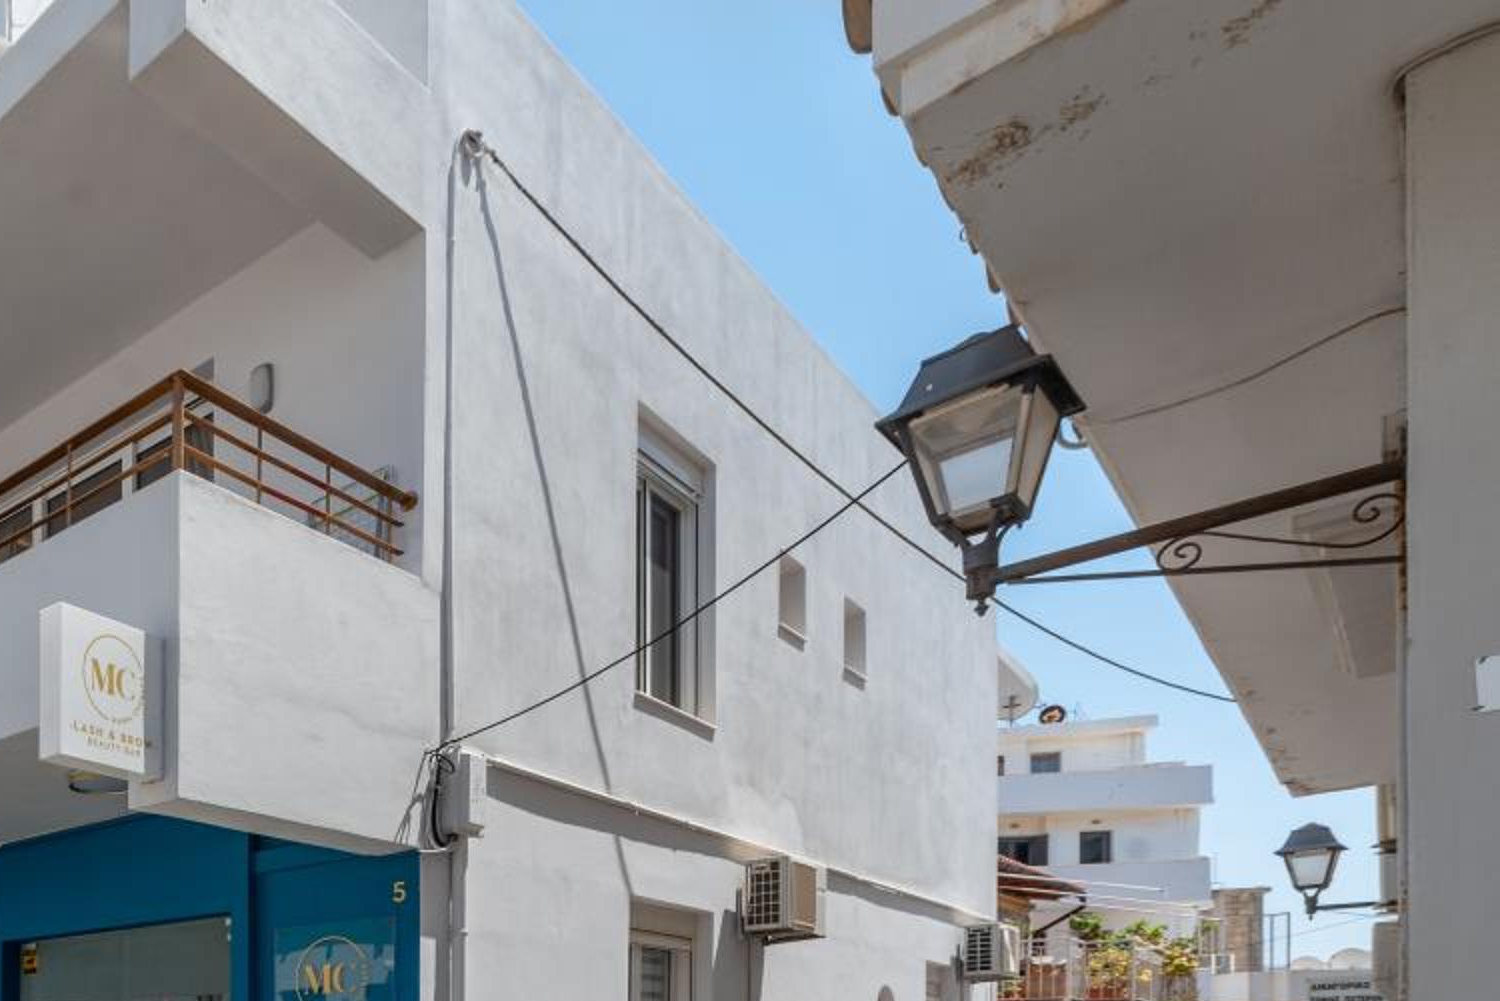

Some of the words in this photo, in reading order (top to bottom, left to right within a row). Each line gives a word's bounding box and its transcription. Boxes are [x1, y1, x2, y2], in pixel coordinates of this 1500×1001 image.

[90, 658, 137, 701] MC
[72, 719, 103, 737] LASH
[391, 881, 407, 903] 5
[303, 962, 358, 995] MC
